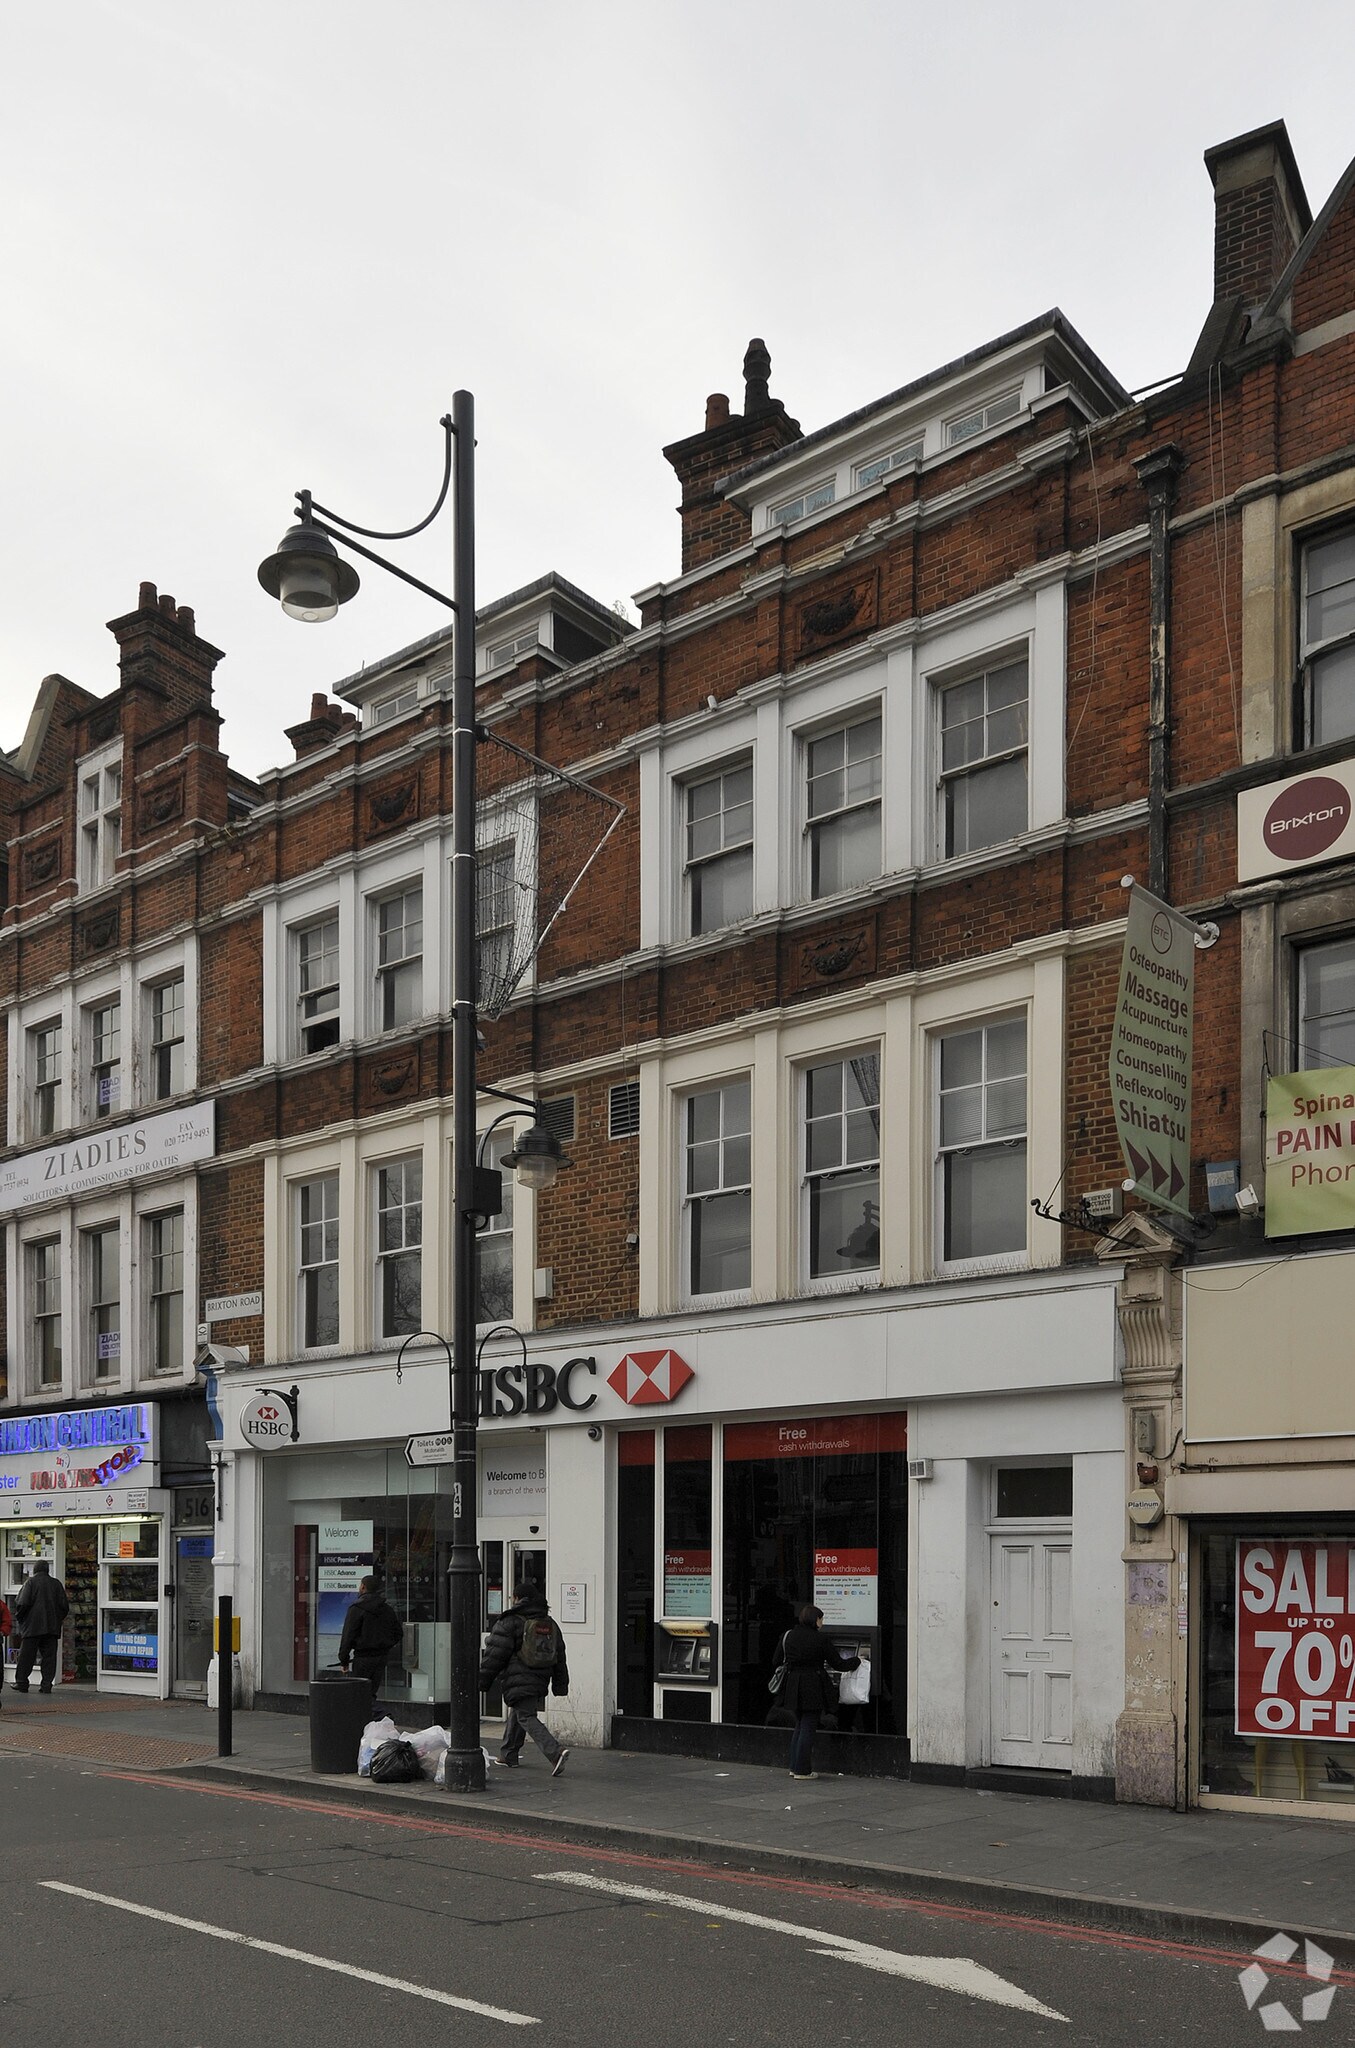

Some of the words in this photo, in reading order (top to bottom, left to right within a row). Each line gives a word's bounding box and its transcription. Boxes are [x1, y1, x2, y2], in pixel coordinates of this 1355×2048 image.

[1270, 805, 1344, 835] Brixton
[1153, 925, 1169, 941] BTC
[1129, 945, 1188, 991] Osteopathy
[1124, 971, 1188, 1019] Massage
[1121, 1000, 1188, 1037] Acupuncture
[1118, 1025, 1187, 1064] Homeopathy
[1116, 1049, 1187, 1089] Counselling
[1116, 1073, 1187, 1112] Reflexology
[1293, 1093, 1355, 1120] Spina
[179, 1121, 194, 1133] FAX
[1119, 1099, 1186, 1142] Shiatsu
[164, 1136, 176, 1148] 020
[1277, 1122, 1342, 1155] PAIN
[44, 1129, 147, 1181] ZIADIES
[23, 1185, 63, 1203] SOLICITORS
[64, 1183, 69, 1193] &
[71, 1167, 133, 1190] COMMISSIONERS
[135, 1161, 151, 1174] FOR
[152, 1154, 179, 1169] OATHS
[207, 1299, 238, 1311] BRIXTON
[240, 1295, 260, 1306] ROAD
[57, 1405, 143, 1446] CENTRAL
[248, 1420, 289, 1436] HSBC
[779, 1427, 807, 1440] Free
[778, 1442, 797, 1452] cash
[799, 1439, 850, 1451] withdrawals
[486, 1471, 527, 1481] Welcome
[528, 1471, 537, 1480] to
[493, 1487, 514, 1496] branch
[515, 1486, 522, 1495] of
[523, 1485, 533, 1494] the
[36, 1500, 53, 1510] oyster
[185, 1497, 209, 1518] 516
[325, 1527, 359, 1538] Welcome
[665, 1554, 684, 1564] Free
[815, 1553, 838, 1564] Free
[815, 1565, 830, 1573] cash
[831, 1565, 871, 1573] withdrawals
[1242, 1547, 1355, 1614] SAL
[1287, 1617, 1309, 1629] UP
[1313, 1617, 1335, 1629] TO
[115, 1634, 133, 1644] CALLING
[134, 1635, 147, 1645] CARD
[127, 1645, 136, 1654] AND
[137, 1646, 154, 1656] REPAIR
[1254, 1697, 1355, 1735] OFF
